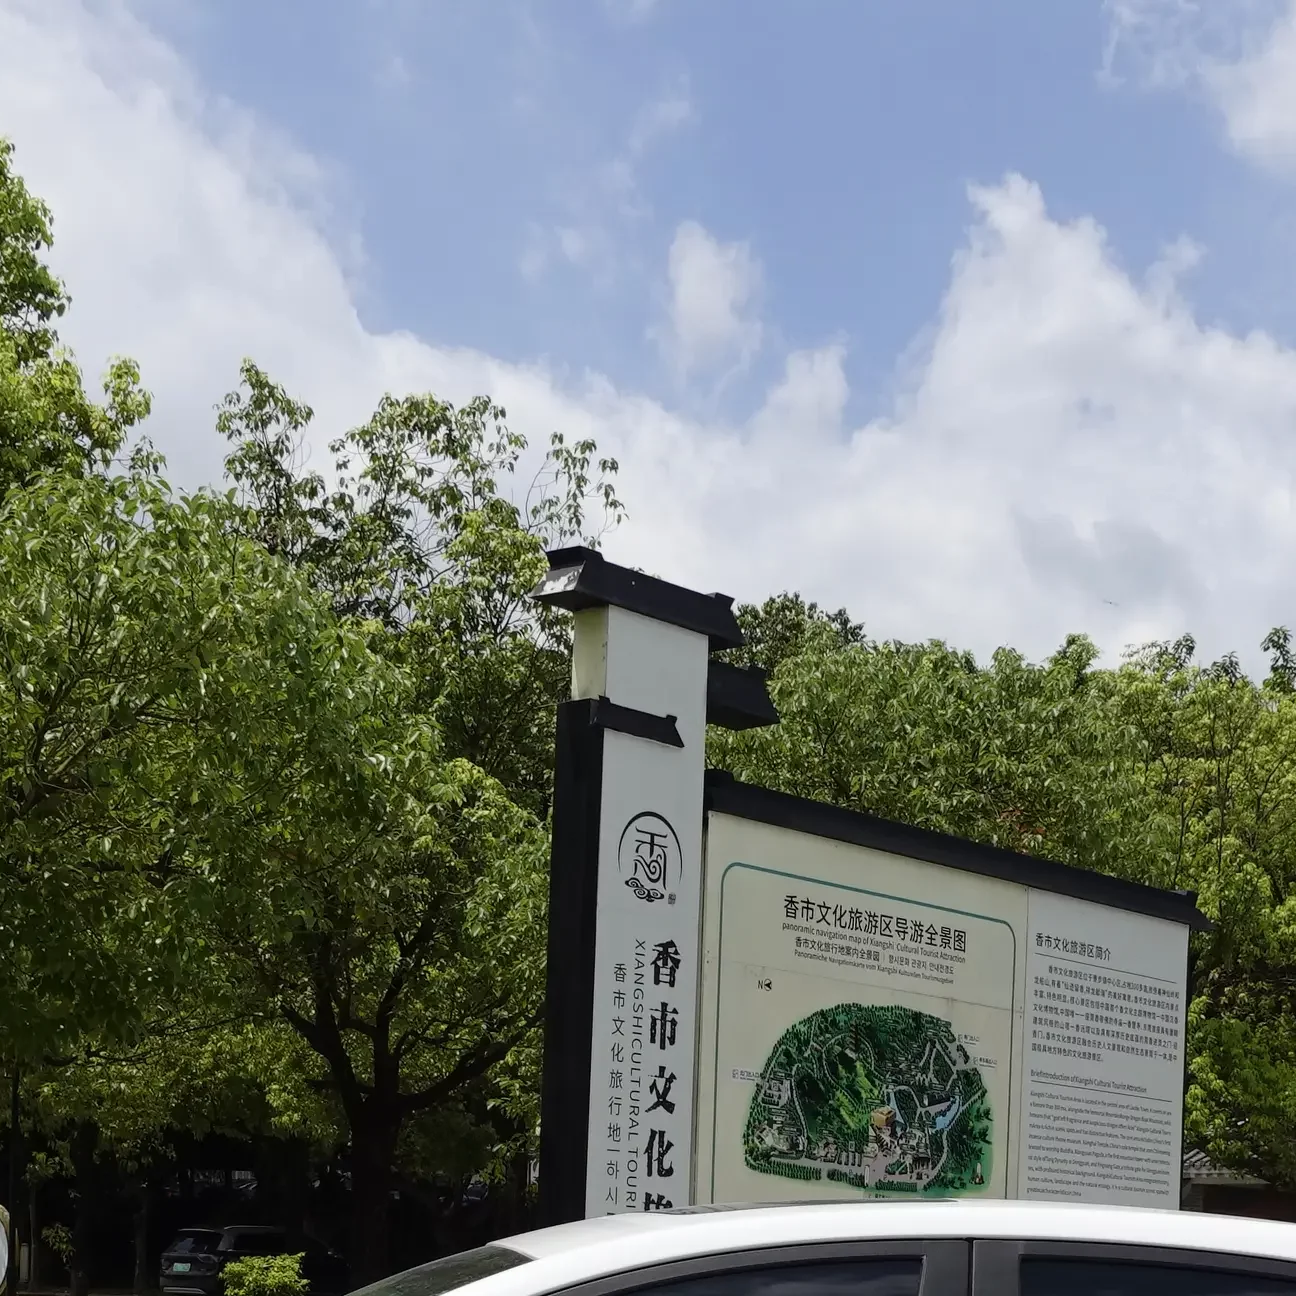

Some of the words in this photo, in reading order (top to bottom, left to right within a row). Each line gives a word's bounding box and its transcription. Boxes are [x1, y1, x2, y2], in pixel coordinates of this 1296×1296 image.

[784, 895, 966, 953] 香市文化旅游区导游全景图
[782, 922, 815, 936] panoramic
[816, 929, 847, 943] navigation
[849, 934, 862, 944] map
[869, 938, 895, 951] Xiangshi
[896, 942, 919, 954] Cultural
[920, 947, 939, 958] Tourist
[939, 951, 966, 963] Attraction
[1035, 932, 1111, 961] 香市文化旅游区简介
[757, 979, 764, 990] N
